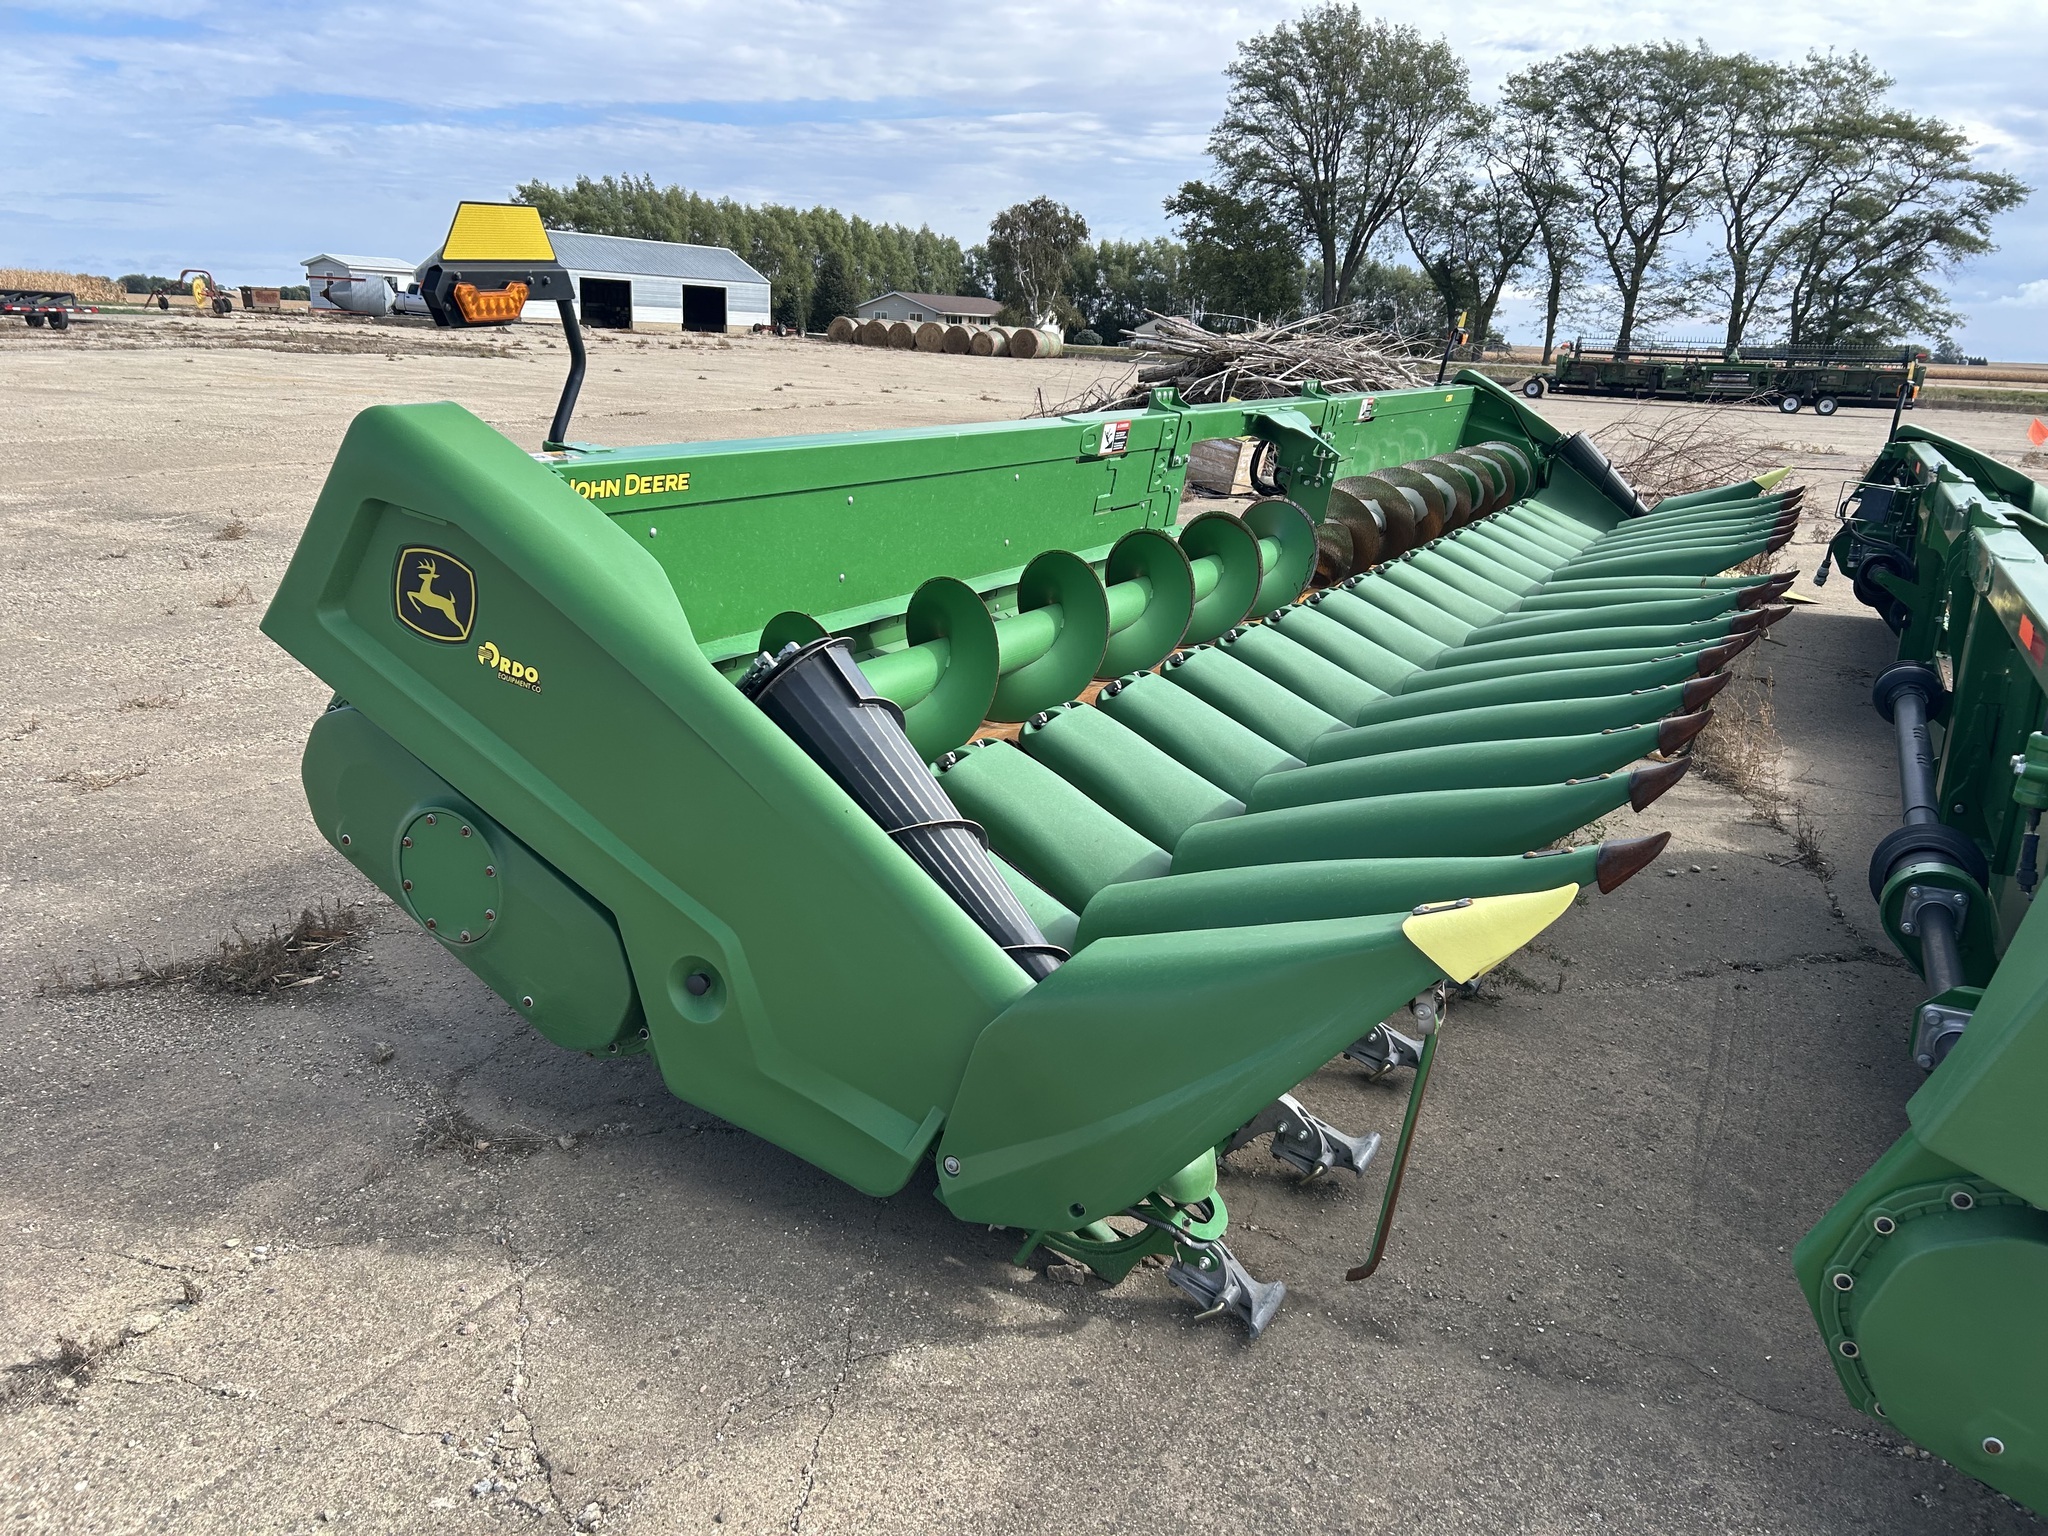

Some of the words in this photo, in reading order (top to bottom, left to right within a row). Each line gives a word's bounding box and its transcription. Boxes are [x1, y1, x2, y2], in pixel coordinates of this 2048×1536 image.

[624, 472, 690, 496] DEERE
[499, 656, 539, 683] RDO
[497, 671, 531, 690] EQUIPMENT
[531, 684, 542, 693] CO
